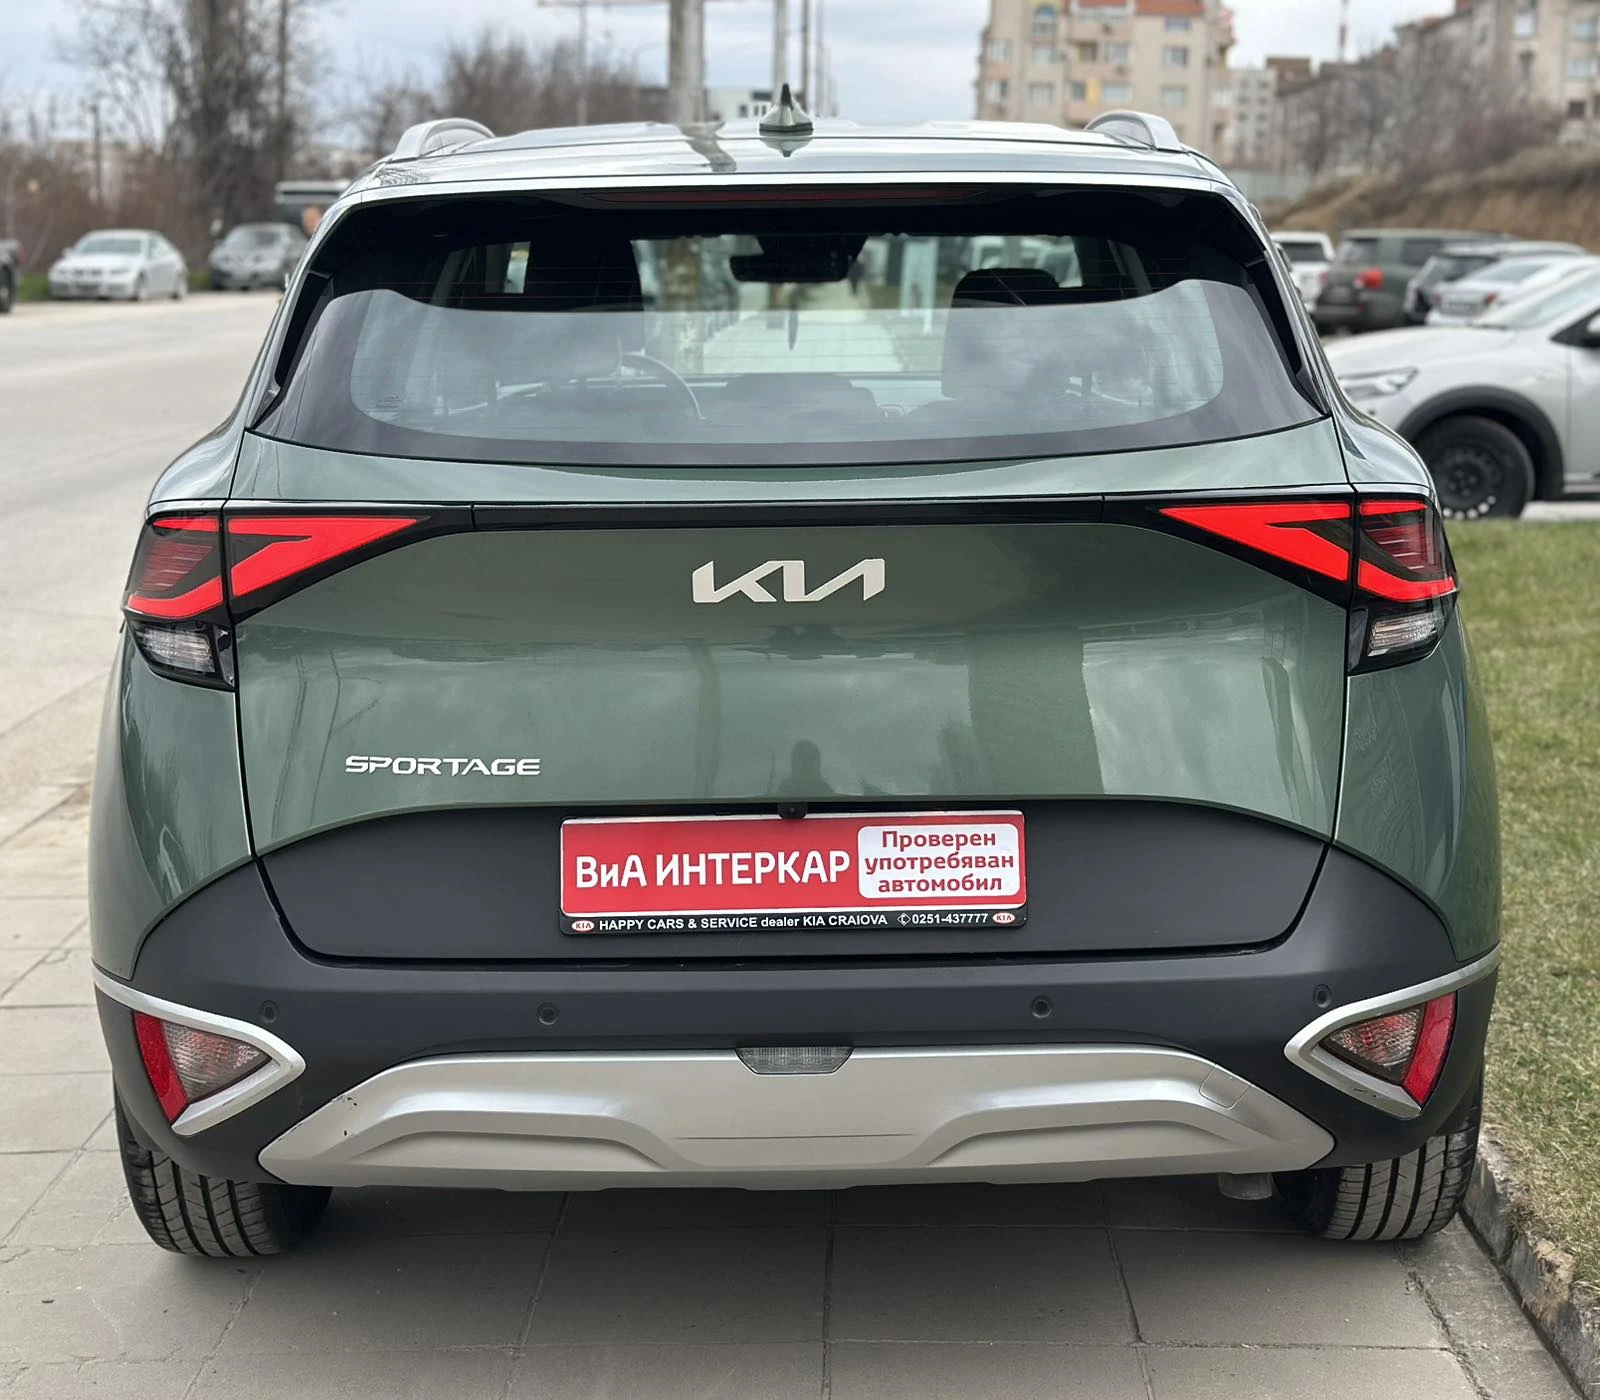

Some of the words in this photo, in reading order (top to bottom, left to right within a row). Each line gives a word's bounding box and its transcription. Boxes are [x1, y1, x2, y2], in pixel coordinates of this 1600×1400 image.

[692, 558, 885, 603] KIA
[345, 755, 541, 776] SPORTAGE
[882, 830, 996, 851] Проверен
[576, 854, 647, 888] ВиА
[656, 850, 851, 886] ИНТЕРКАР
[864, 851, 1014, 875] употребяван
[878, 873, 1002, 892] автомобил
[599, 919, 645, 930] HAPPY
[647, 919, 684, 929] CARS
[687, 918, 698, 929] &
[700, 917, 758, 929] SERVICE
[760, 916, 800, 928] dealer
[802, 915, 826, 926] KIA
[828, 914, 888, 926] CRAIOVA
[911, 913, 989, 925] 0251-437777
